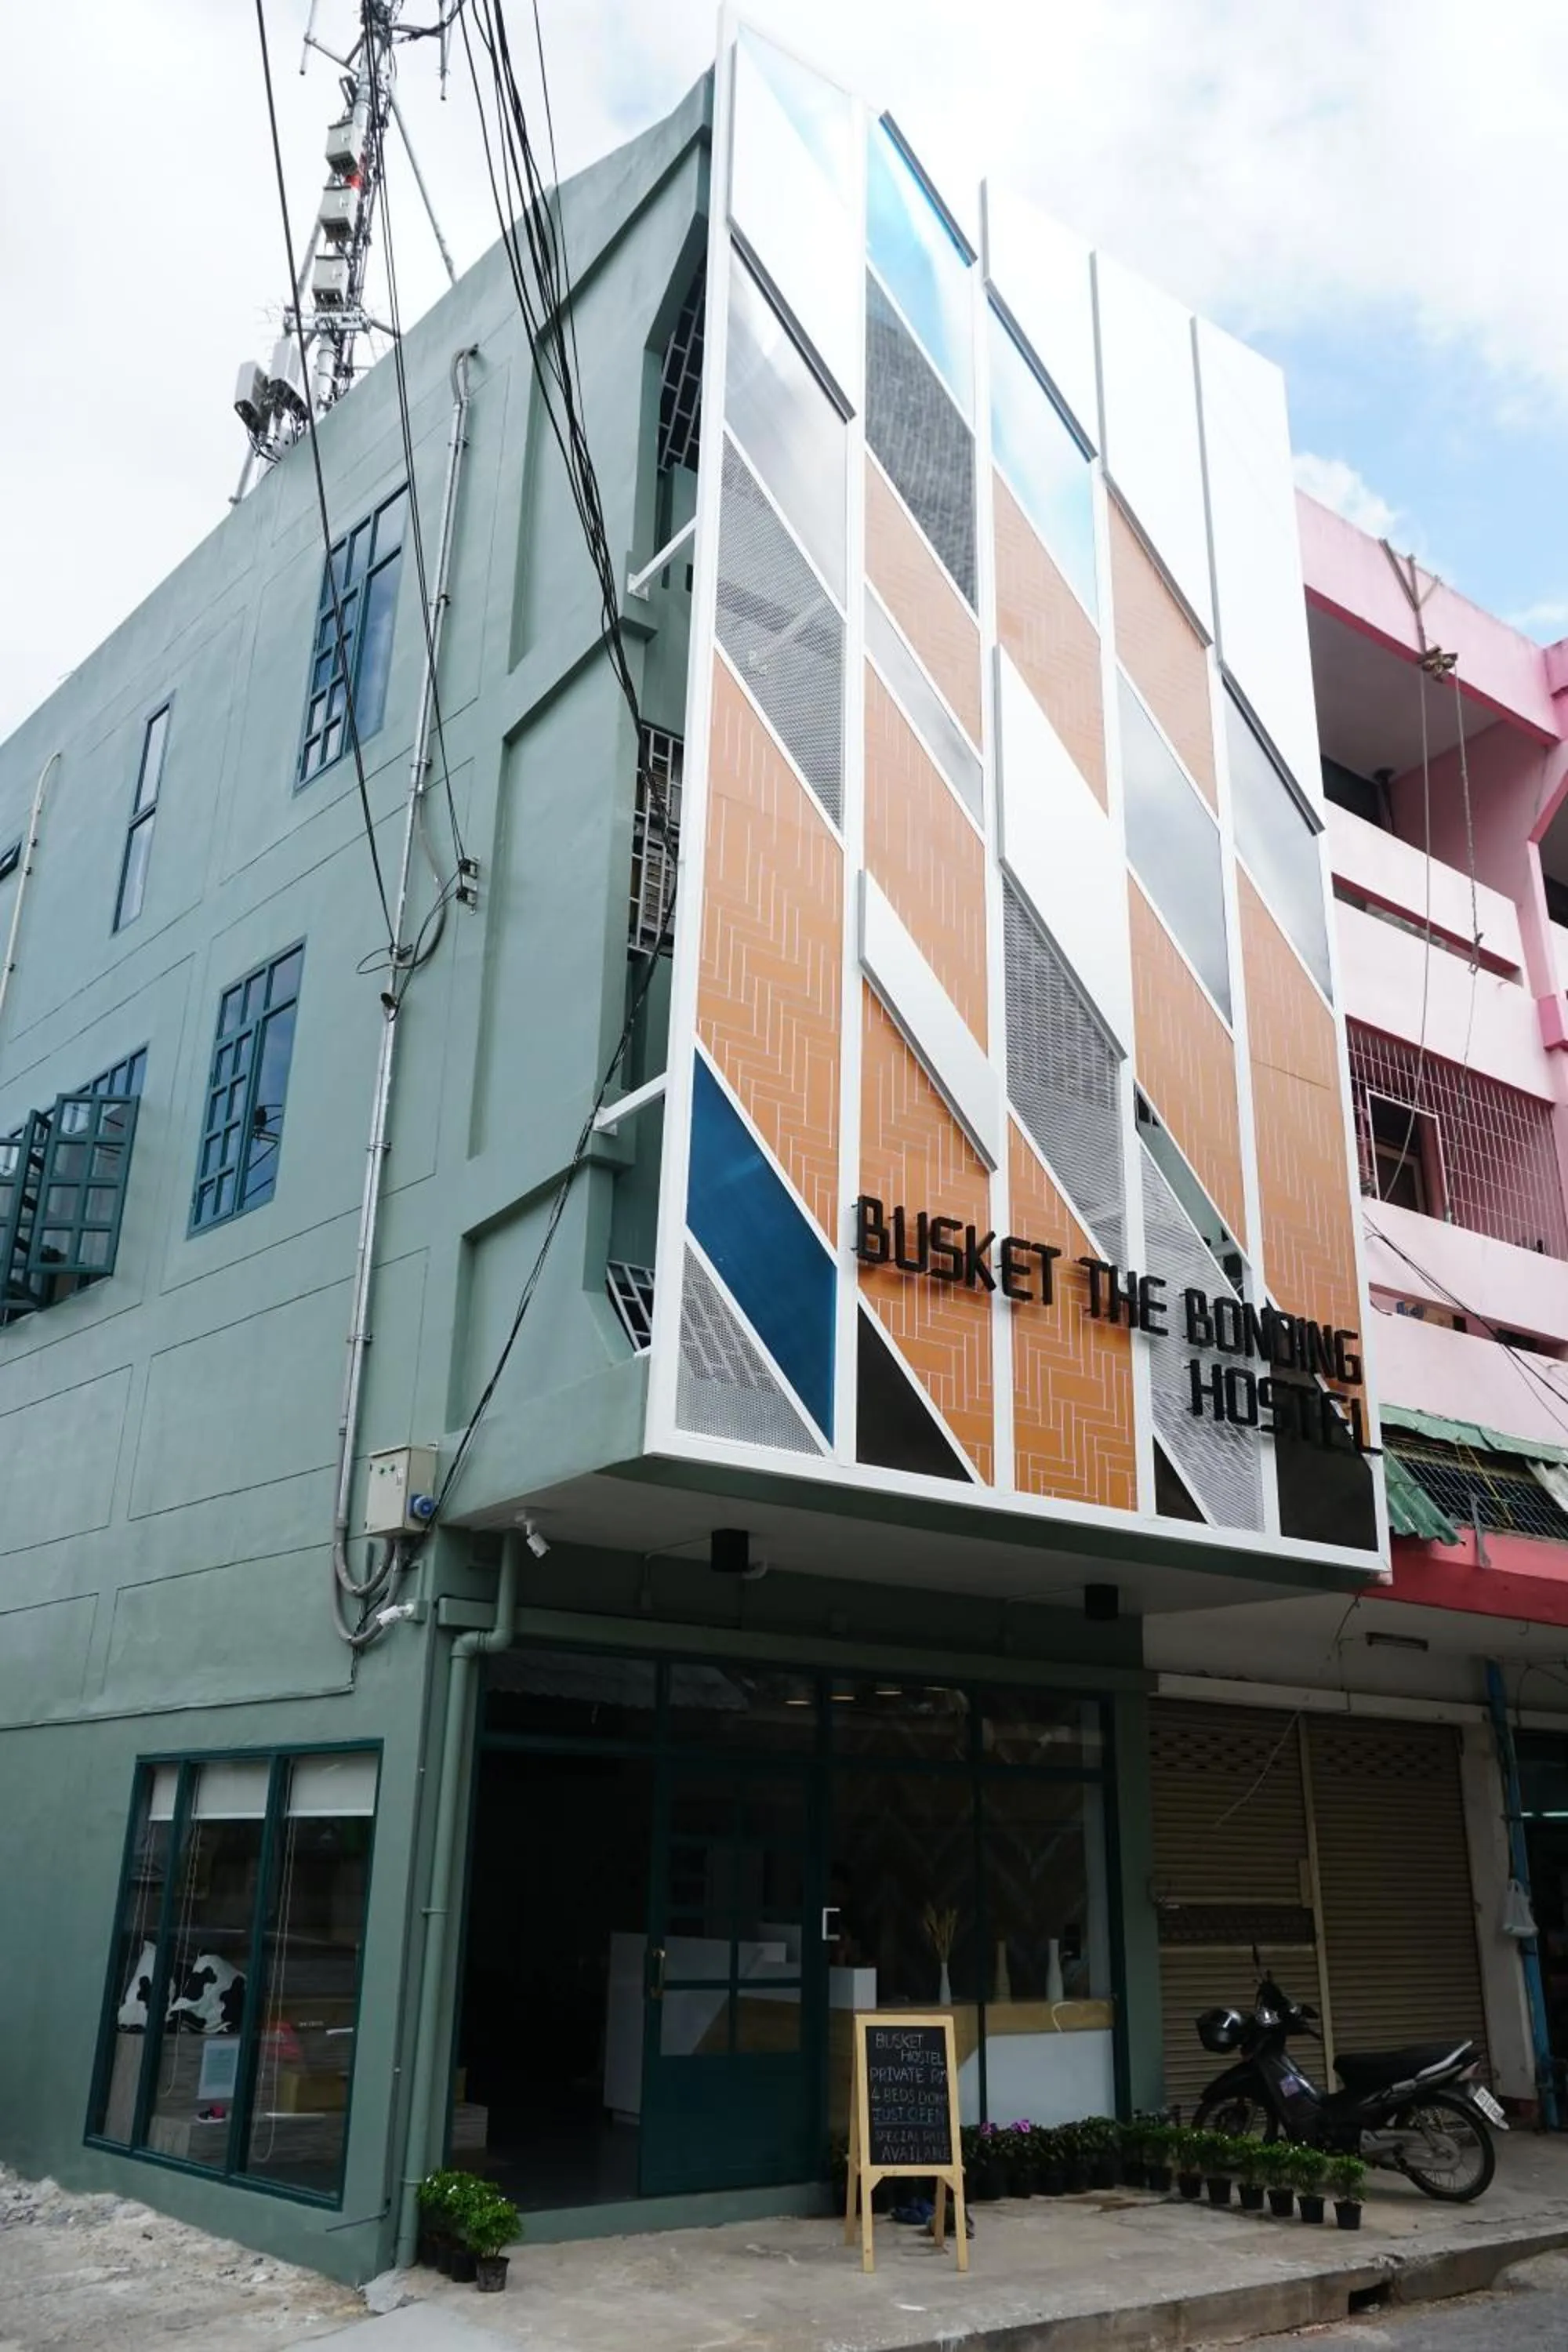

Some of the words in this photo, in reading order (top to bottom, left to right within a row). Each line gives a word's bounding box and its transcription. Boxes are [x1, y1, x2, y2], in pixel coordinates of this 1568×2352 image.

[857, 1196, 1062, 1305] BUSKET
[1078, 1257, 1169, 1337] THE
[1185, 1287, 1363, 1385] BONDING
[1189, 1359, 1382, 1455] HOSTEL
[876, 2032, 924, 2049] BUSKET
[901, 2049, 944, 2067] HOSTEL
[869, 2067, 924, 2083] PRIVATE
[871, 2085, 880, 2102] 4
[884, 2088, 915, 2105] BEDS
[872, 2107, 904, 2121] JUST
